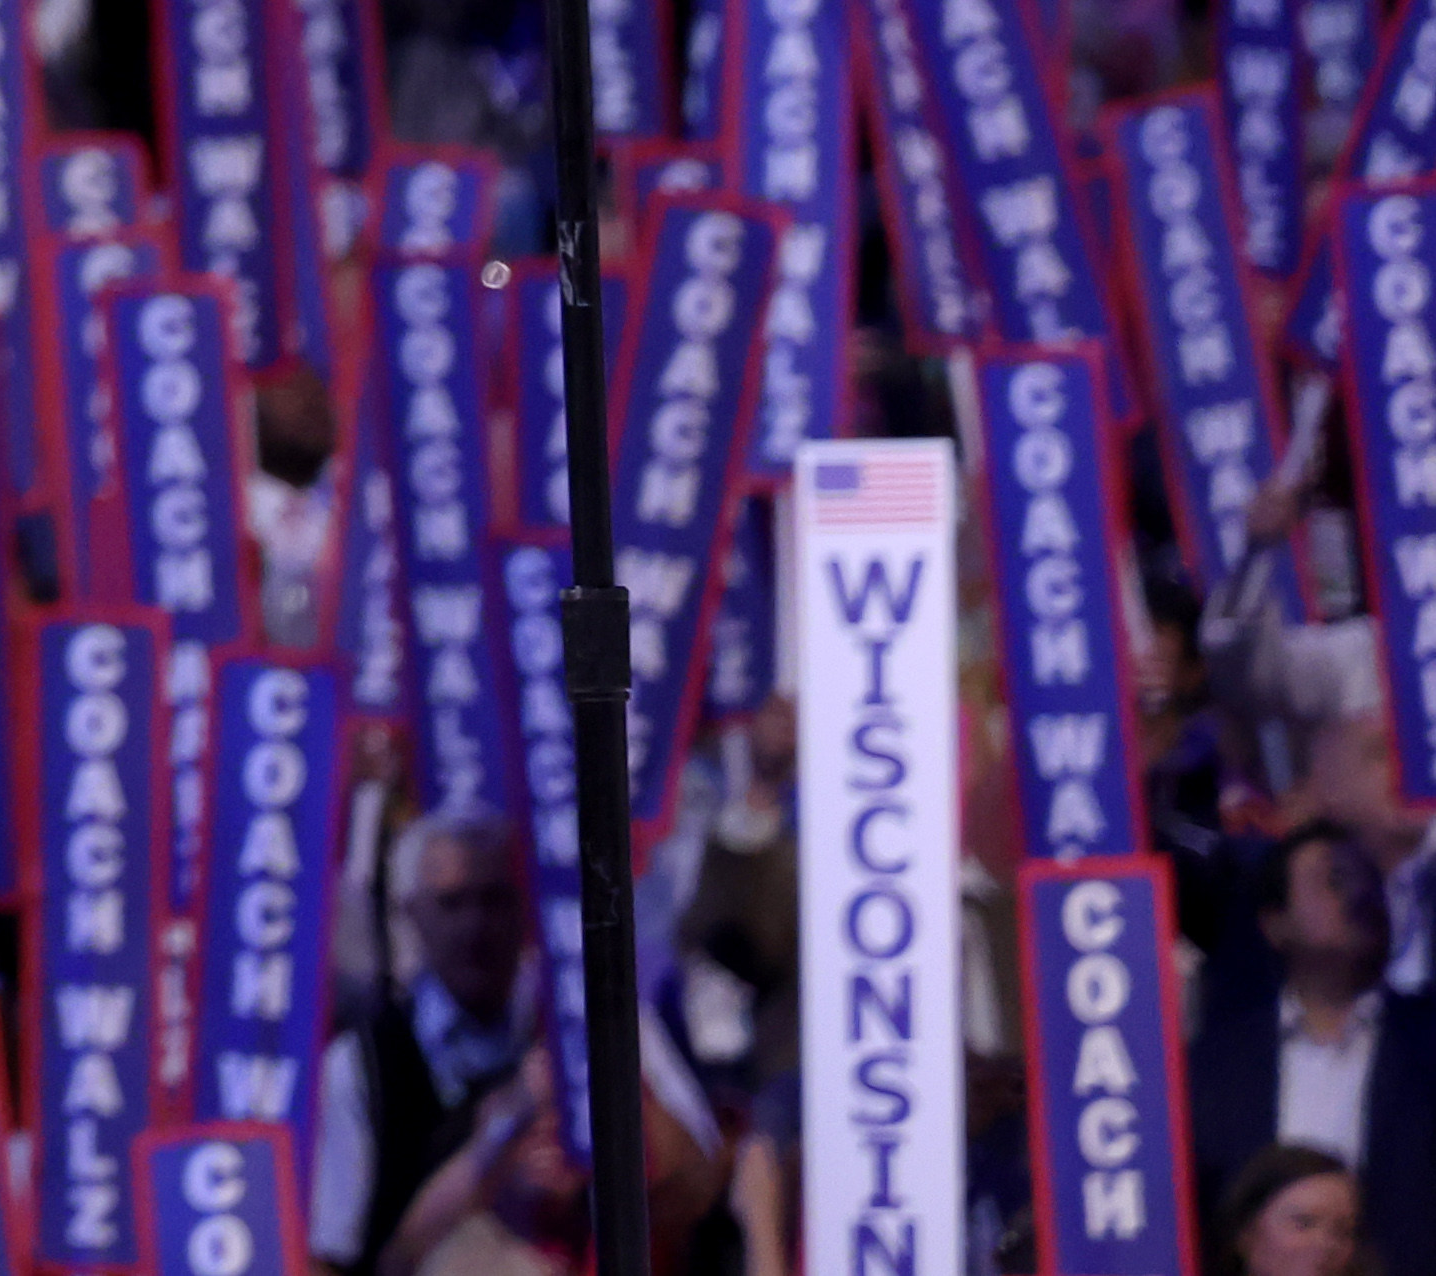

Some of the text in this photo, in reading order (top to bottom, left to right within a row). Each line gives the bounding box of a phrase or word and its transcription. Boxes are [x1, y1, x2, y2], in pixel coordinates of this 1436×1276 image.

[638, 209, 745, 529] COACH
[981, 172, 1073, 348] WAL
[1141, 104, 1237, 386] COACH
[139, 293, 215, 612] COACH
[395, 266, 468, 558] COACH
[1008, 362, 1089, 687] COACH
[55, 622, 136, 1249] COACH WALZ
[229, 667, 311, 1021] COACH
[825, 551, 924, 1276] WISCONSIN
[1061, 879, 1146, 1240] COACH
